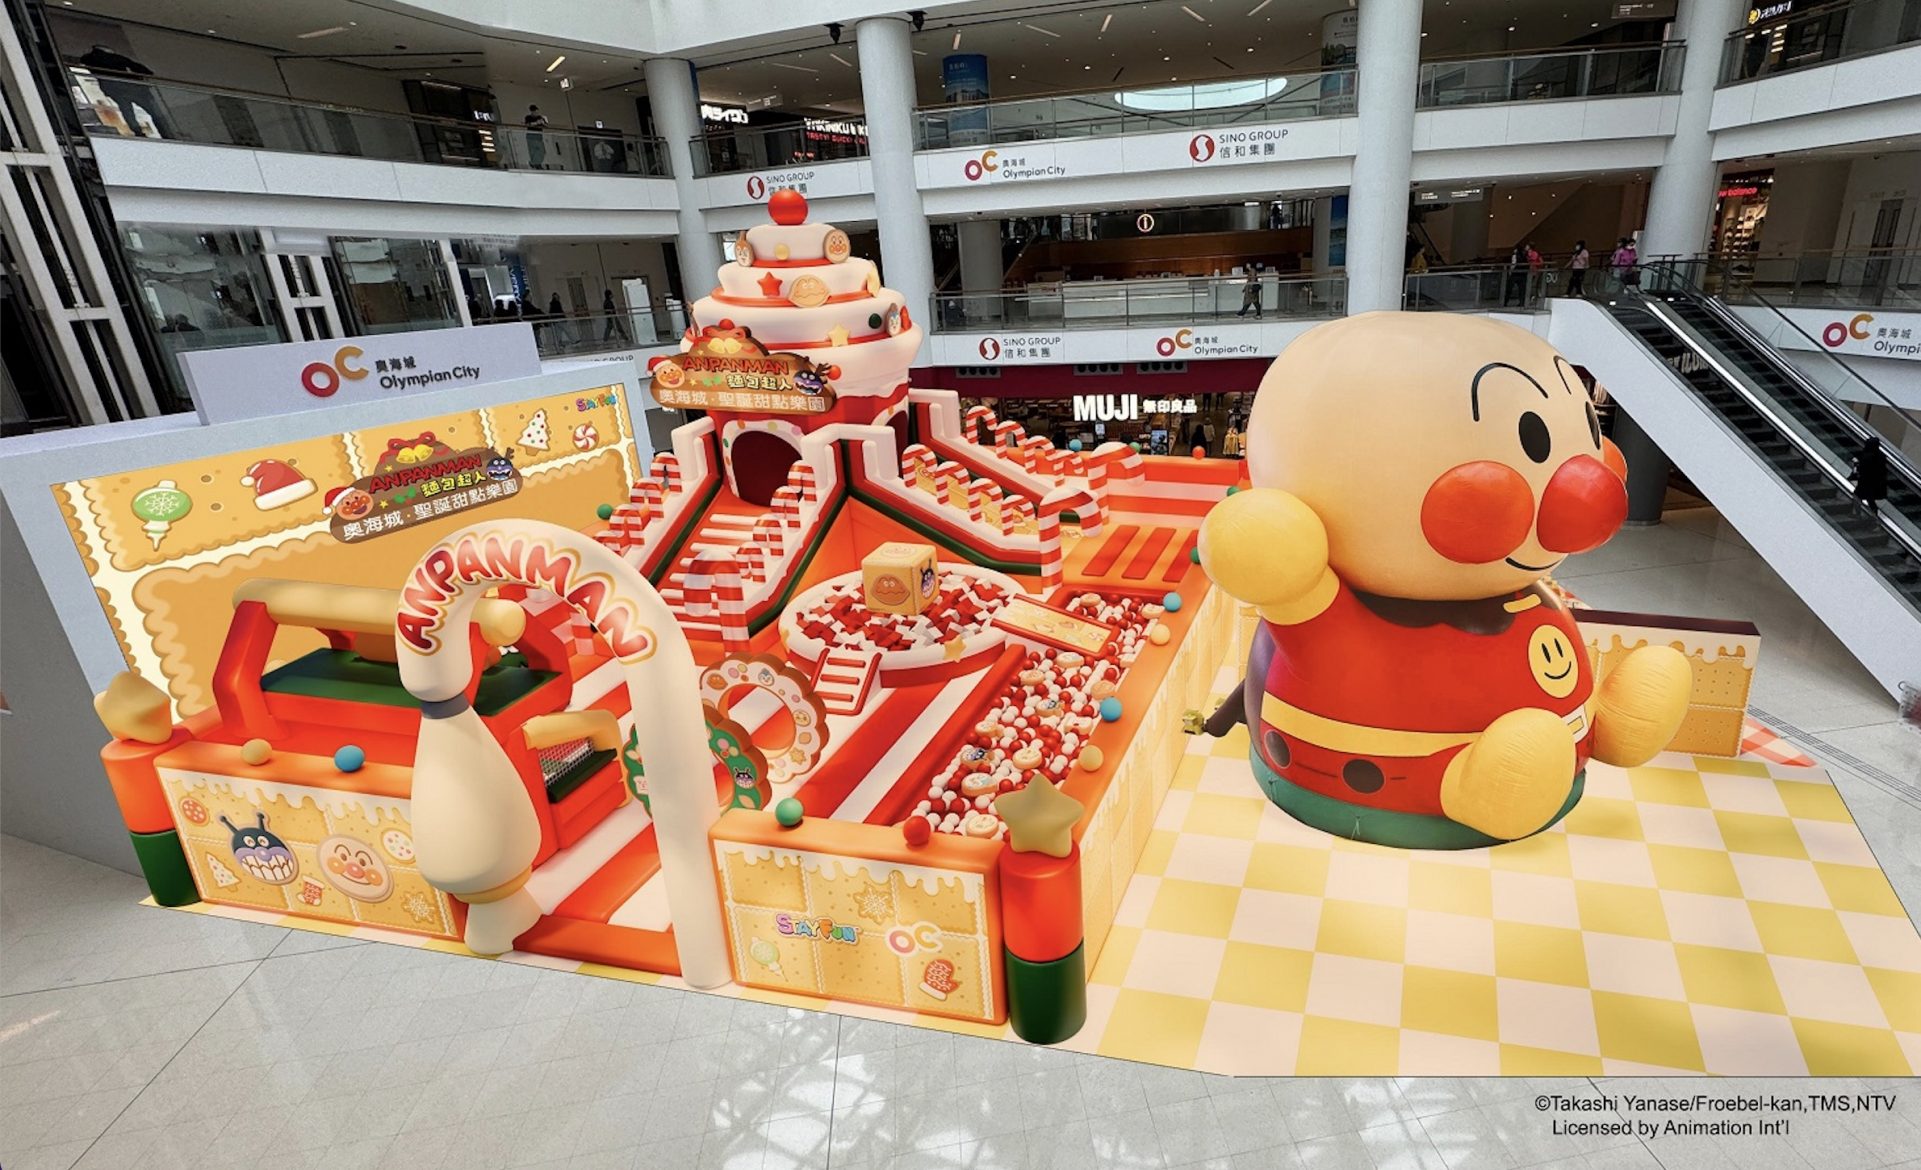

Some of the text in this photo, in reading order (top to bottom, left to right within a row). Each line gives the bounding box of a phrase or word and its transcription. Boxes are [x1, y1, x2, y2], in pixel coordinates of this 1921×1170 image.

[1219, 129, 1289, 144] SINO GROUP
[1219, 143, 1276, 159] 信和集團
[766, 171, 815, 184] SINO GROUP
[965, 150, 998, 181] OC
[1002, 166, 1066, 180] Olympian City
[1003, 337, 1061, 346] SINO GROUP
[1156, 328, 1193, 357] OC
[1822, 313, 1874, 347] OC
[1194, 344, 1259, 356] Olympian City
[301, 345, 370, 398] OC
[379, 364, 481, 390] Olympian City
[683, 357, 790, 375] ANPANMAN
[726, 374, 794, 391] 麵包超人
[1073, 393, 1138, 422] MUJI
[1142, 398, 1198, 414] 無印良品
[368, 453, 483, 494] ANPANMAN
[420, 471, 487, 498] 麵包超人
[397, 537, 649, 658] ANPANMAN
[888, 924, 939, 954] OC
